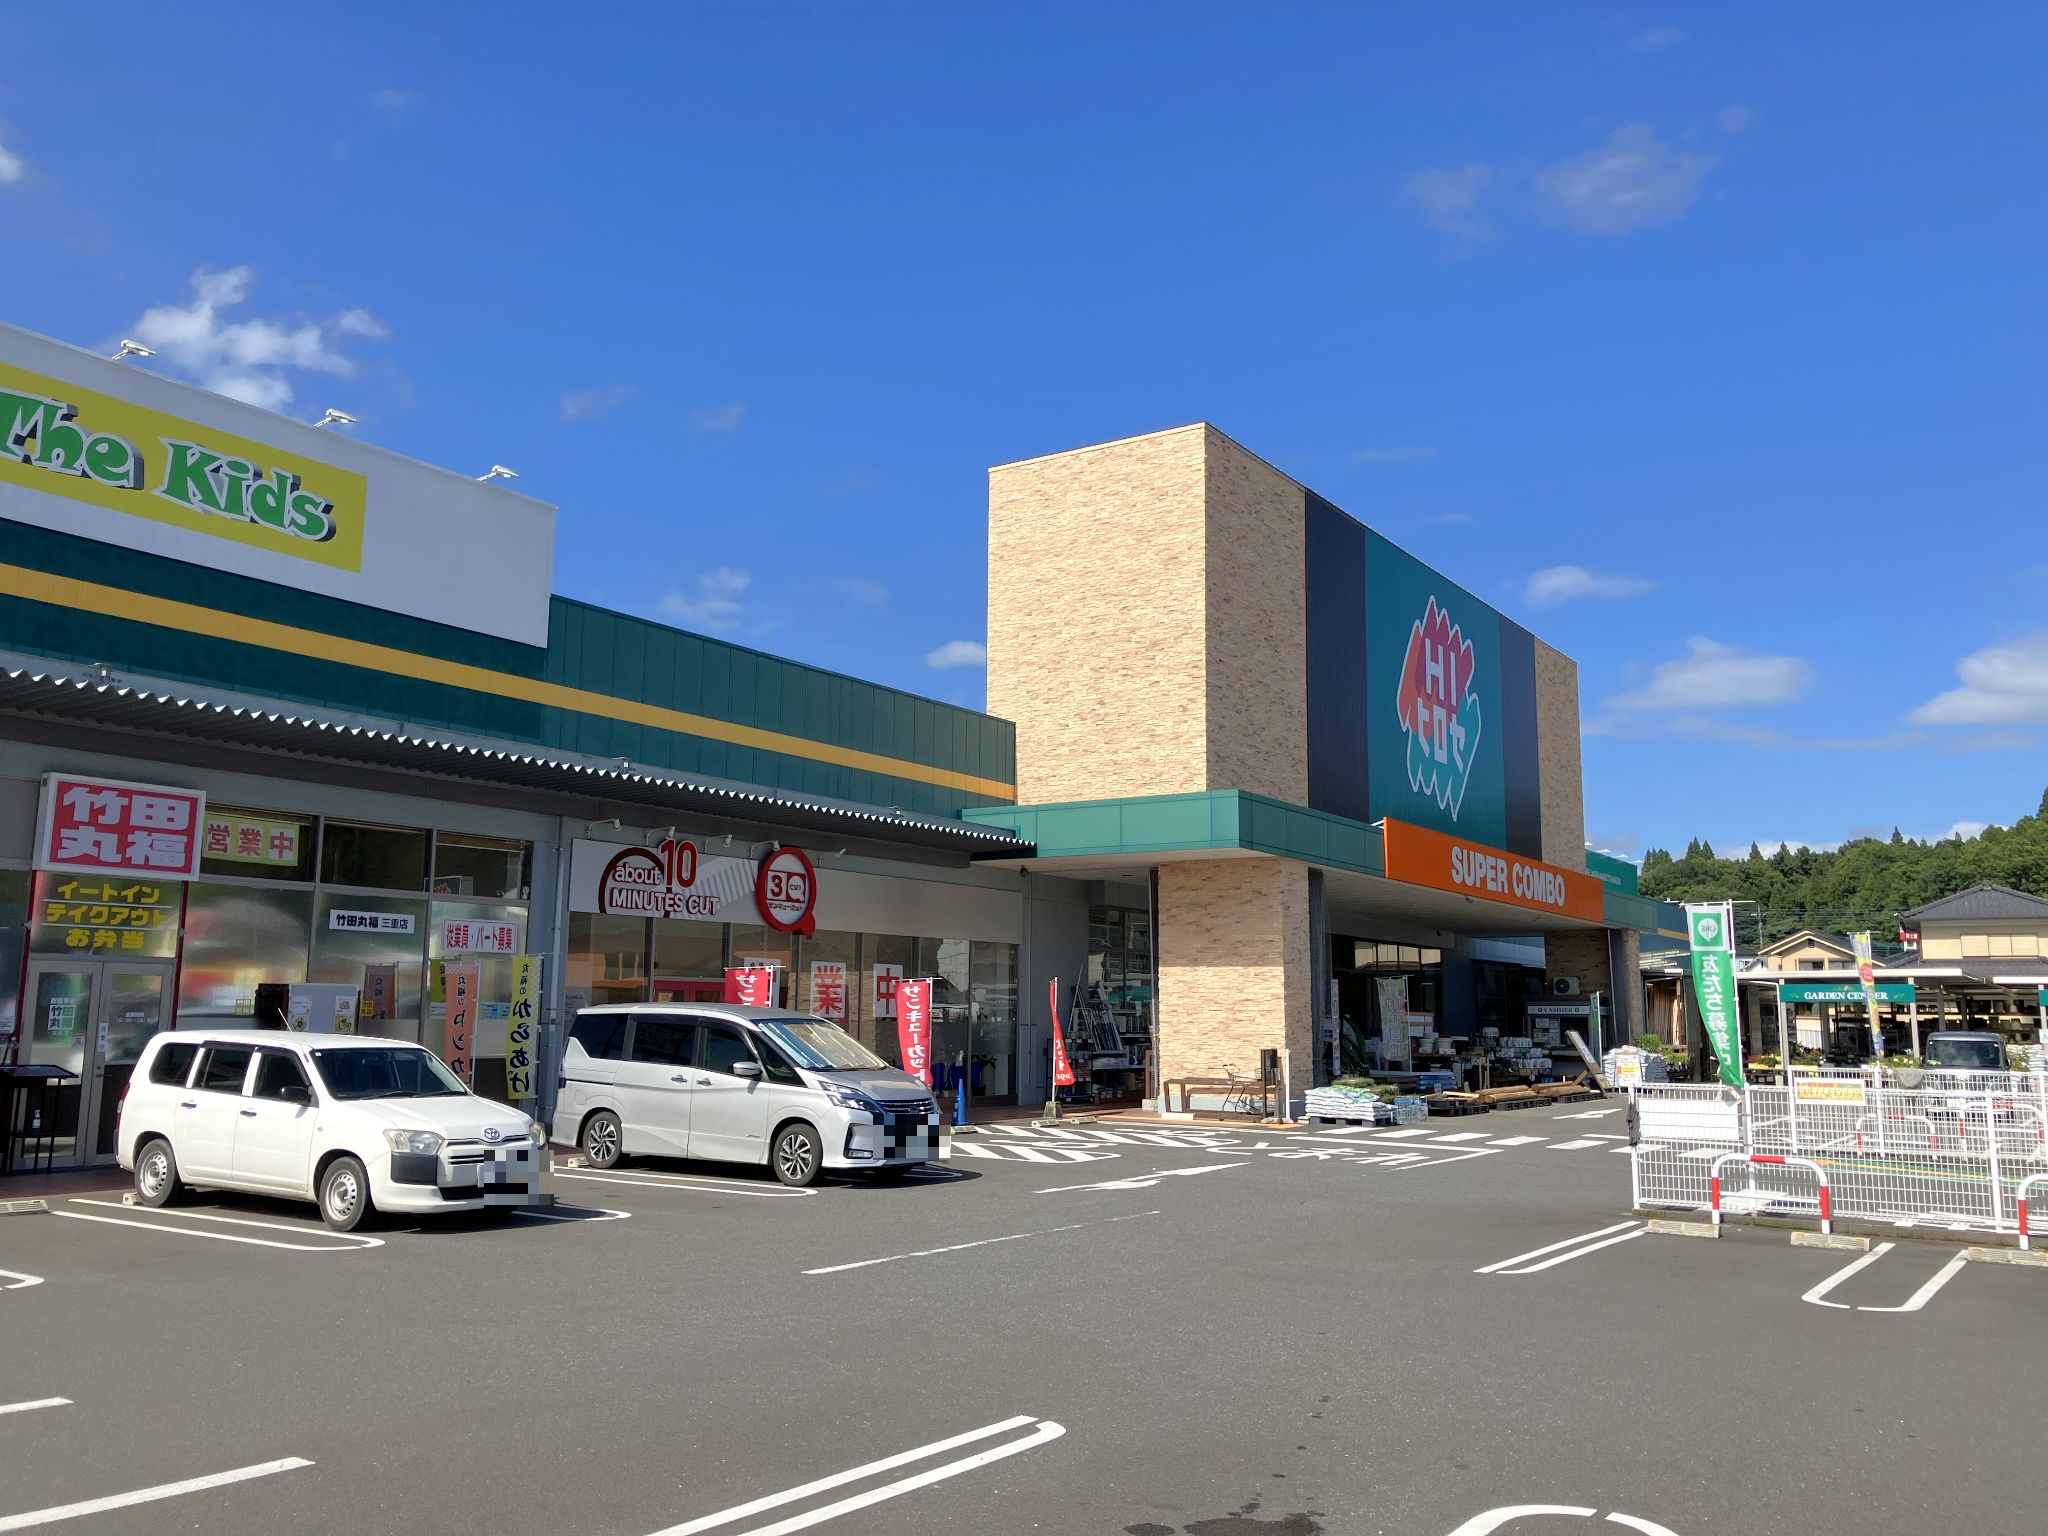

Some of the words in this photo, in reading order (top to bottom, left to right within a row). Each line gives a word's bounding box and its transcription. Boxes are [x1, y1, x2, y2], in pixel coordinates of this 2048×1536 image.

[155, 436, 337, 543] Kids
[1424, 637, 1457, 706] HI
[62, 786, 191, 831] 竹田
[57, 824, 188, 868] 丸福
[207, 822, 294, 859] 営業中
[614, 862, 663, 886] about
[658, 837, 698, 890] 10
[1451, 845, 1509, 895] SUPER
[1511, 861, 1566, 908] COMBO
[57, 881, 160, 904] イートイン
[610, 886, 685, 914] MINUTES
[686, 895, 722, 917] CUT
[46, 904, 168, 927] テイクアウト
[336, 914, 379, 928] 竹田丸福
[381, 918, 408, 930] 三重店
[65, 928, 145, 949] お弁当
[1804, 991, 1845, 1000] GARDEN
[1846, 991, 1888, 1000] CENER
[1205, 1142, 1431, 1166] とまれ
